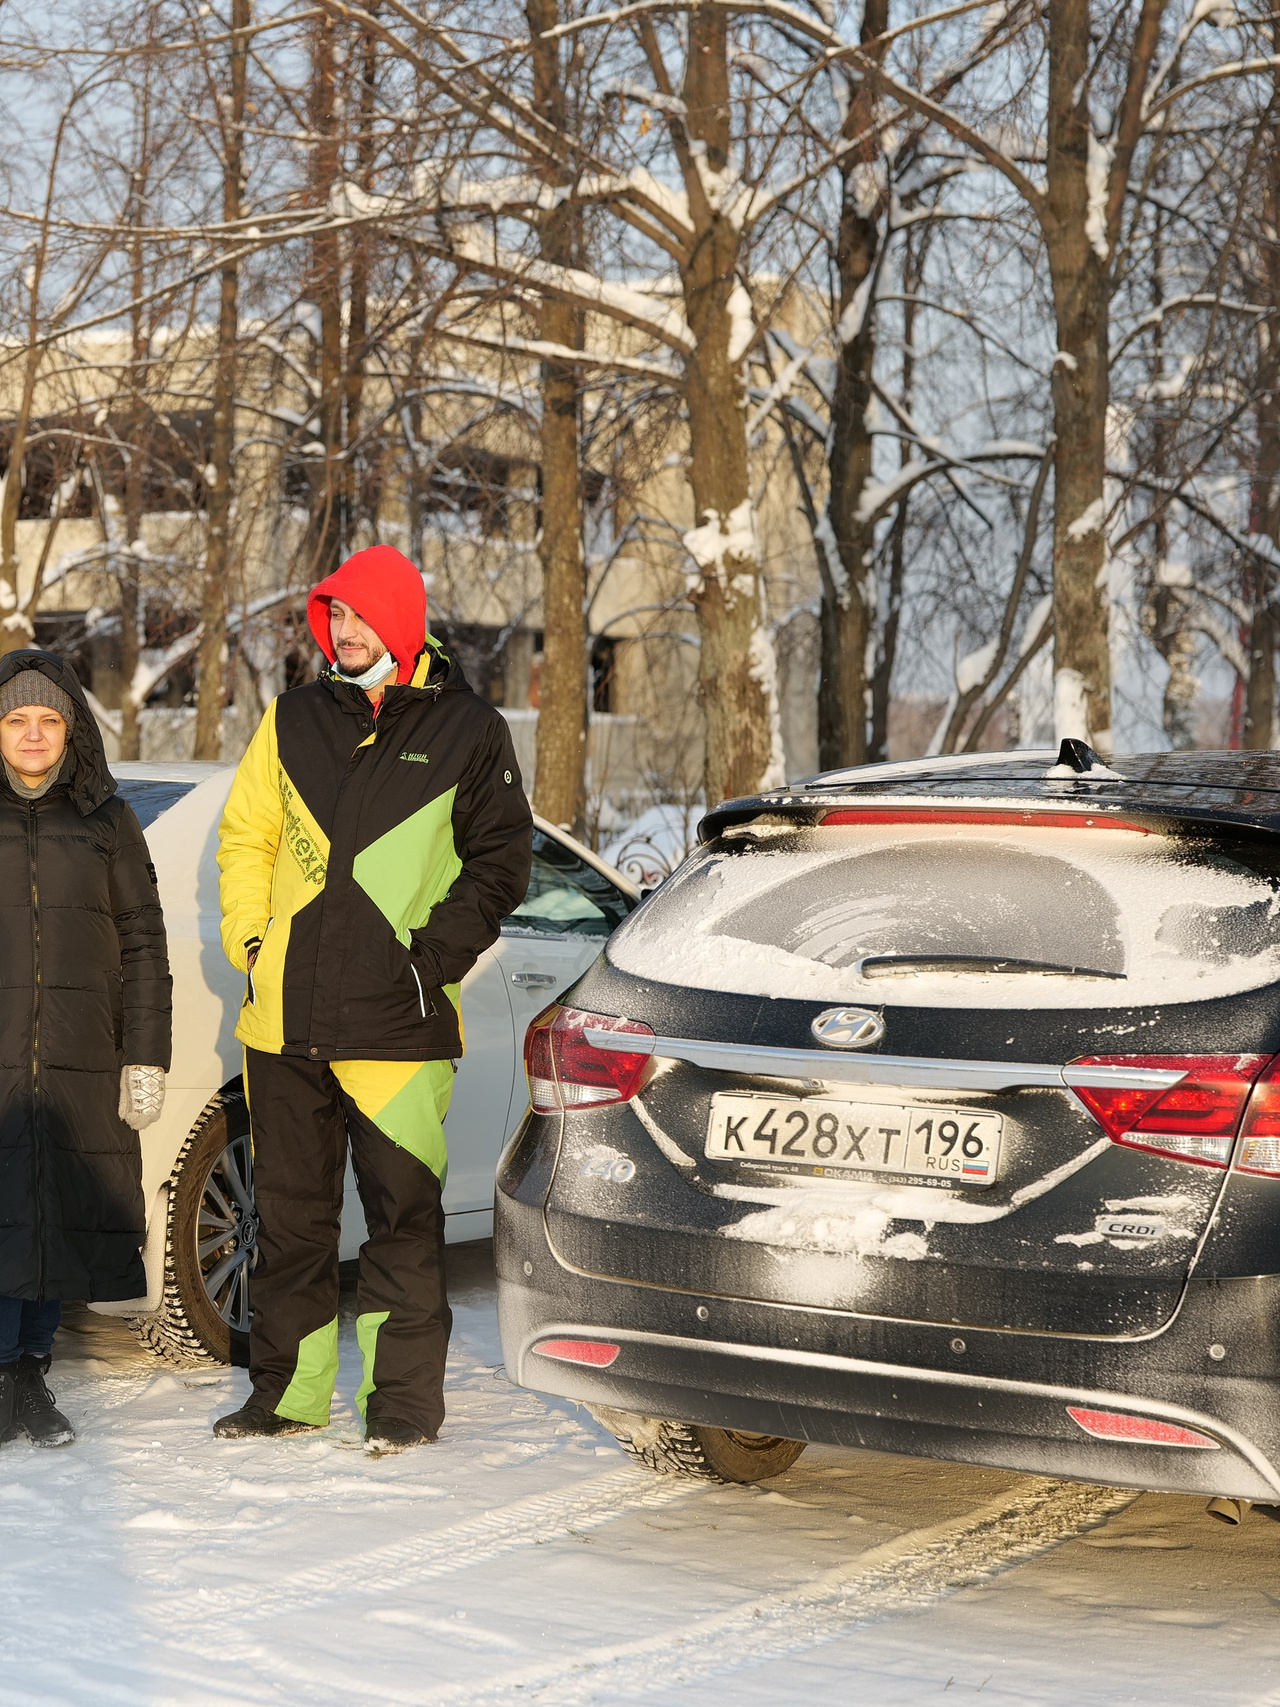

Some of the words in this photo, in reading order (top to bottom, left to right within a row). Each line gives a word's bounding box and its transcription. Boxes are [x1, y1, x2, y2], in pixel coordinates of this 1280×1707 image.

[914, 1118, 983, 1159] 196
[925, 1156, 960, 1172] RUS
[1108, 1223, 1157, 1235] CRDi
